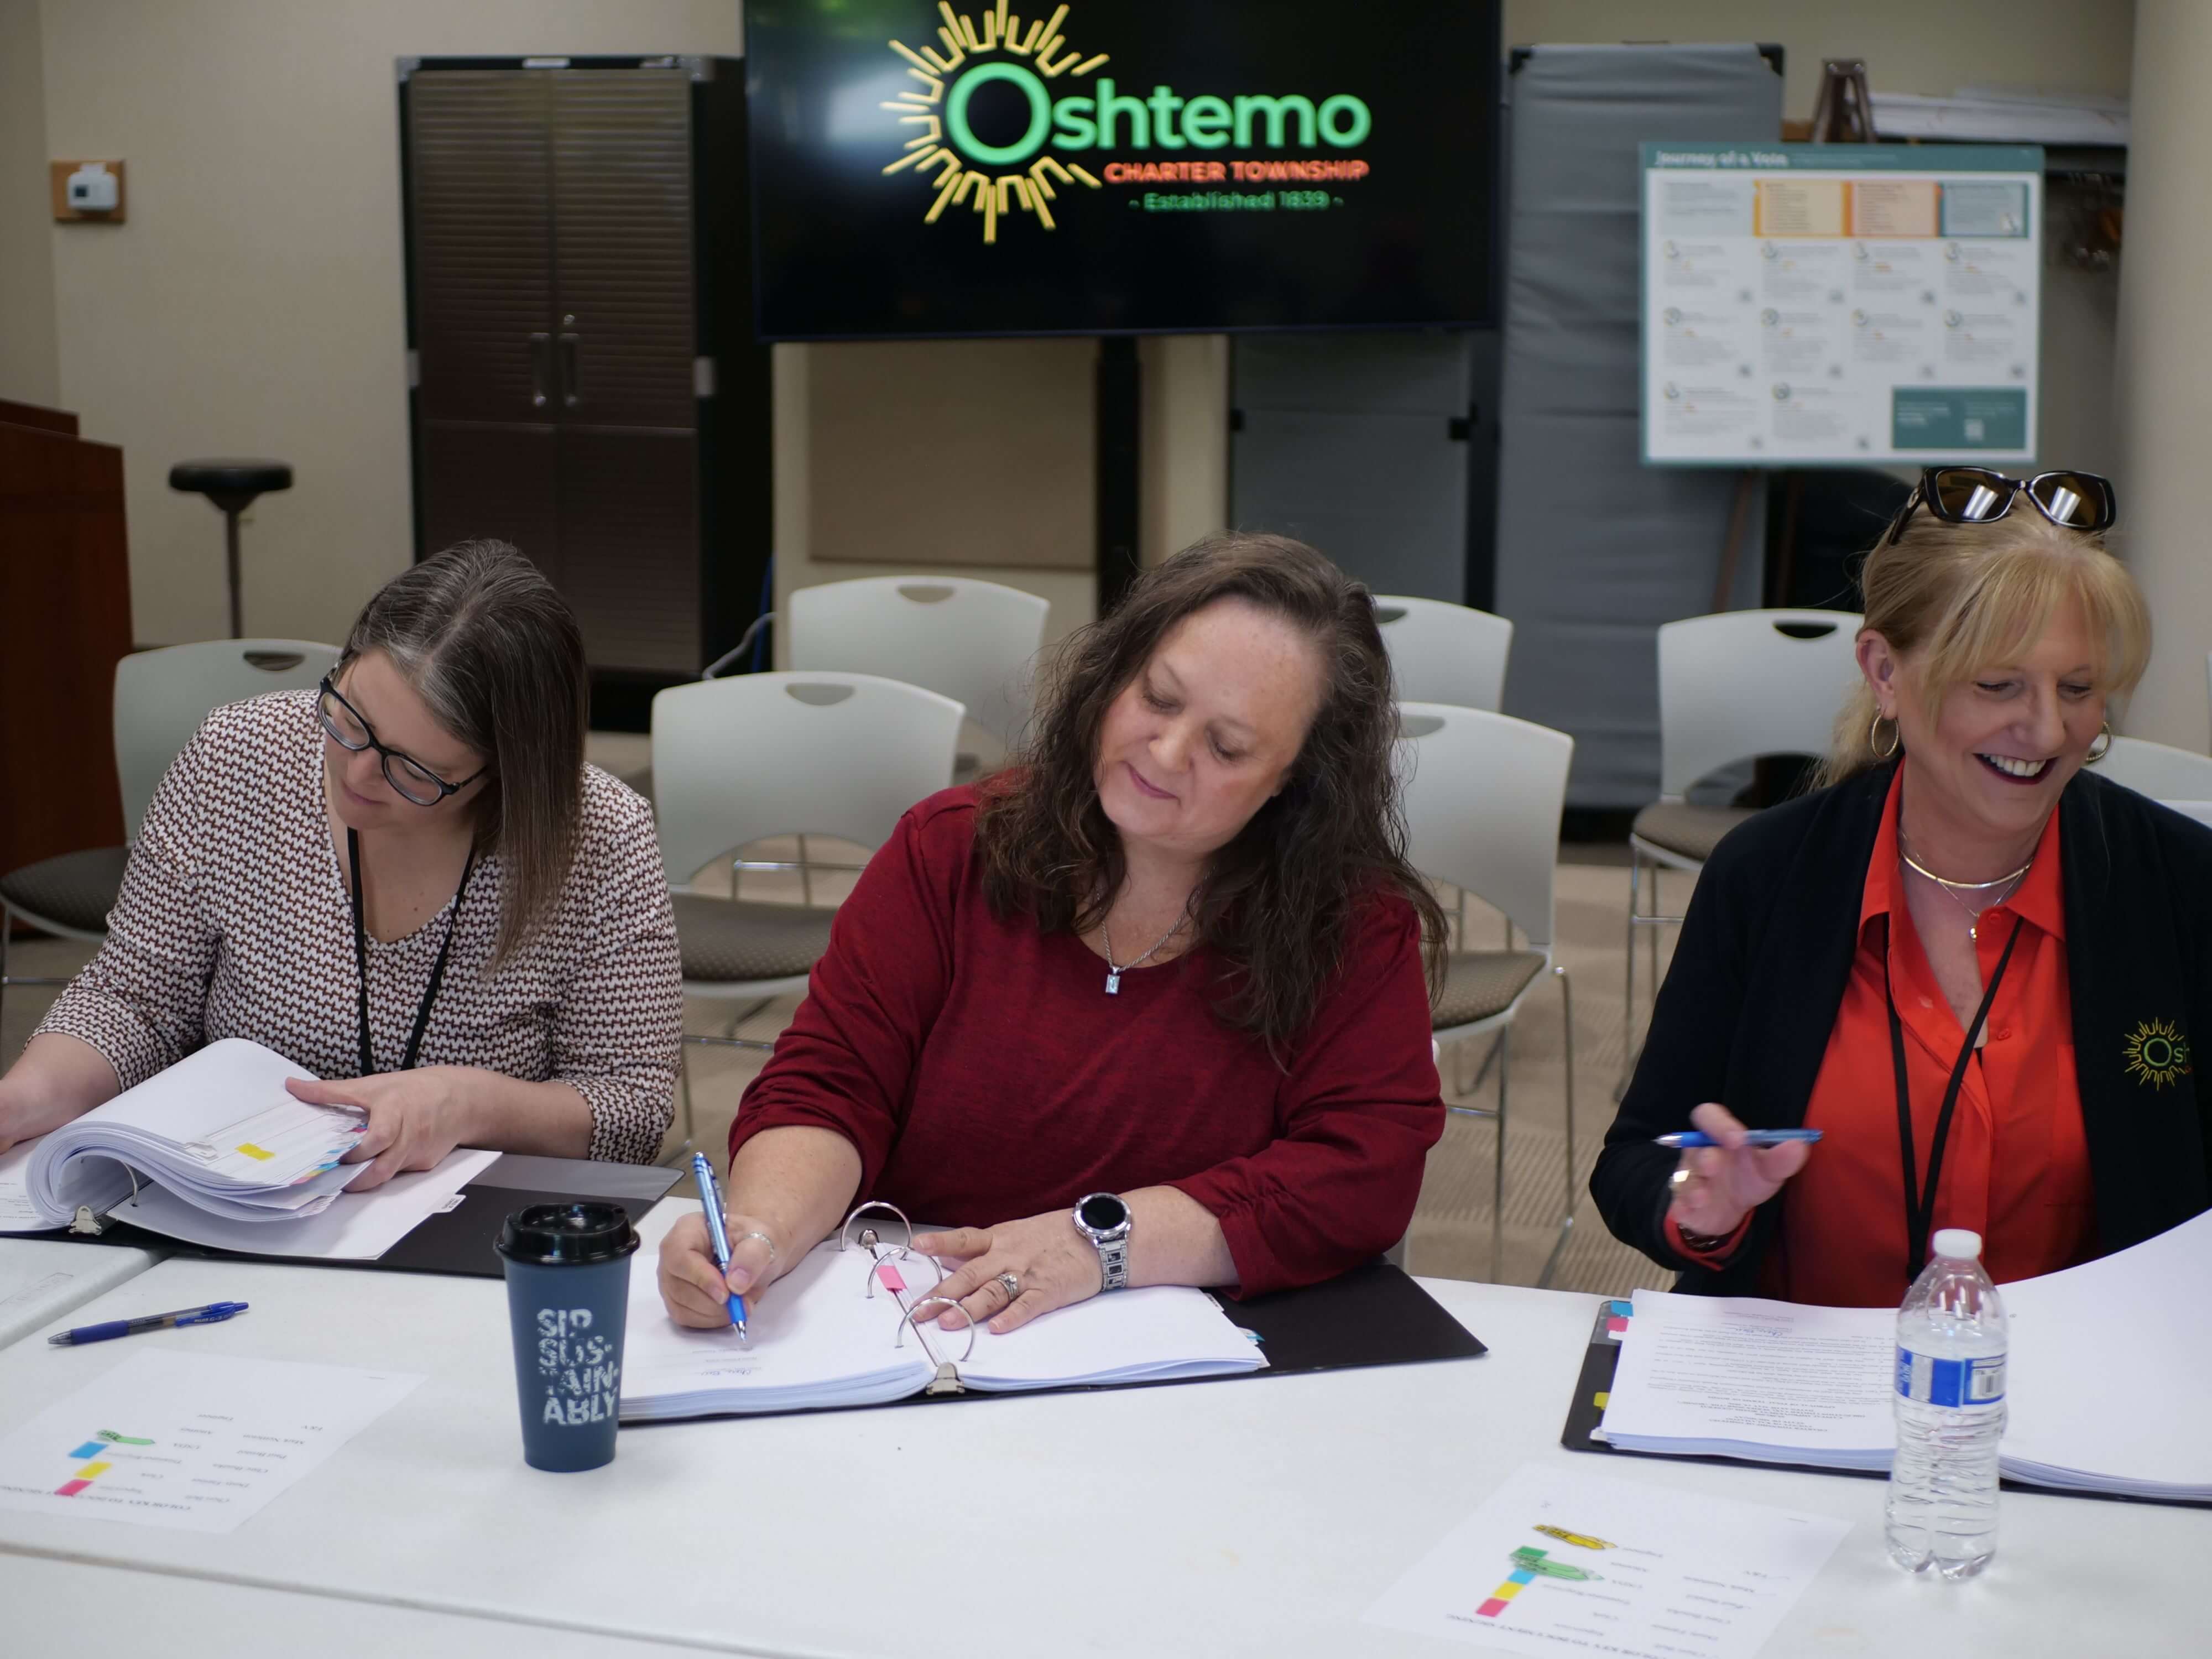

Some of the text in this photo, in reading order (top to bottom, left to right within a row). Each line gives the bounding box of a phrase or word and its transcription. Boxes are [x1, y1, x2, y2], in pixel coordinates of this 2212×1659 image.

[945, 61, 1372, 166] Oshtemo
[1103, 160, 1370, 184] CHARTER TOWNSHIP
[1143, 191, 1276, 212] Established
[1279, 190, 1330, 210] 1839
[536, 1308, 593, 1338] SIP
[543, 1386, 618, 1425] ABLY
